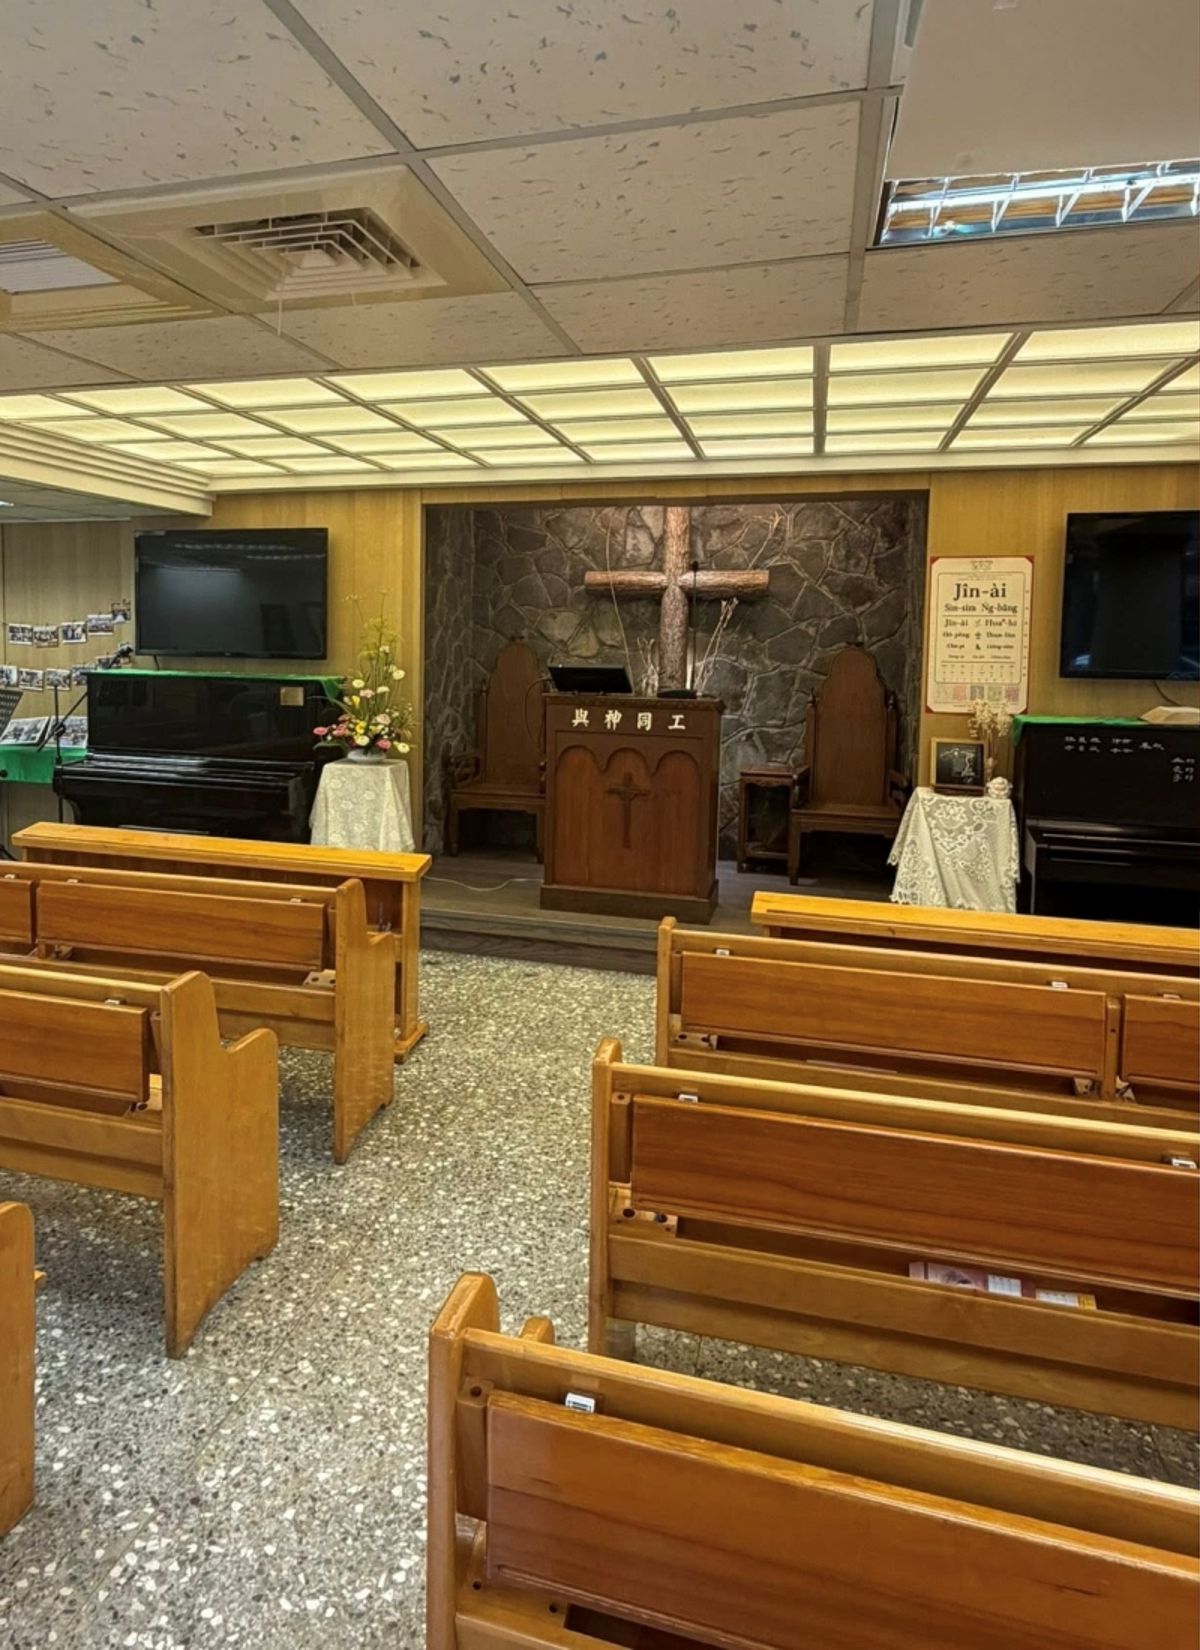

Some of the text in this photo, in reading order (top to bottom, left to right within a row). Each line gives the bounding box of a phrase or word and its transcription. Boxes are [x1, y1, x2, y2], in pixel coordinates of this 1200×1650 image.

[953, 583, 1007, 600] Jîn-ài
[571, 708, 686, 731] 與神同工
